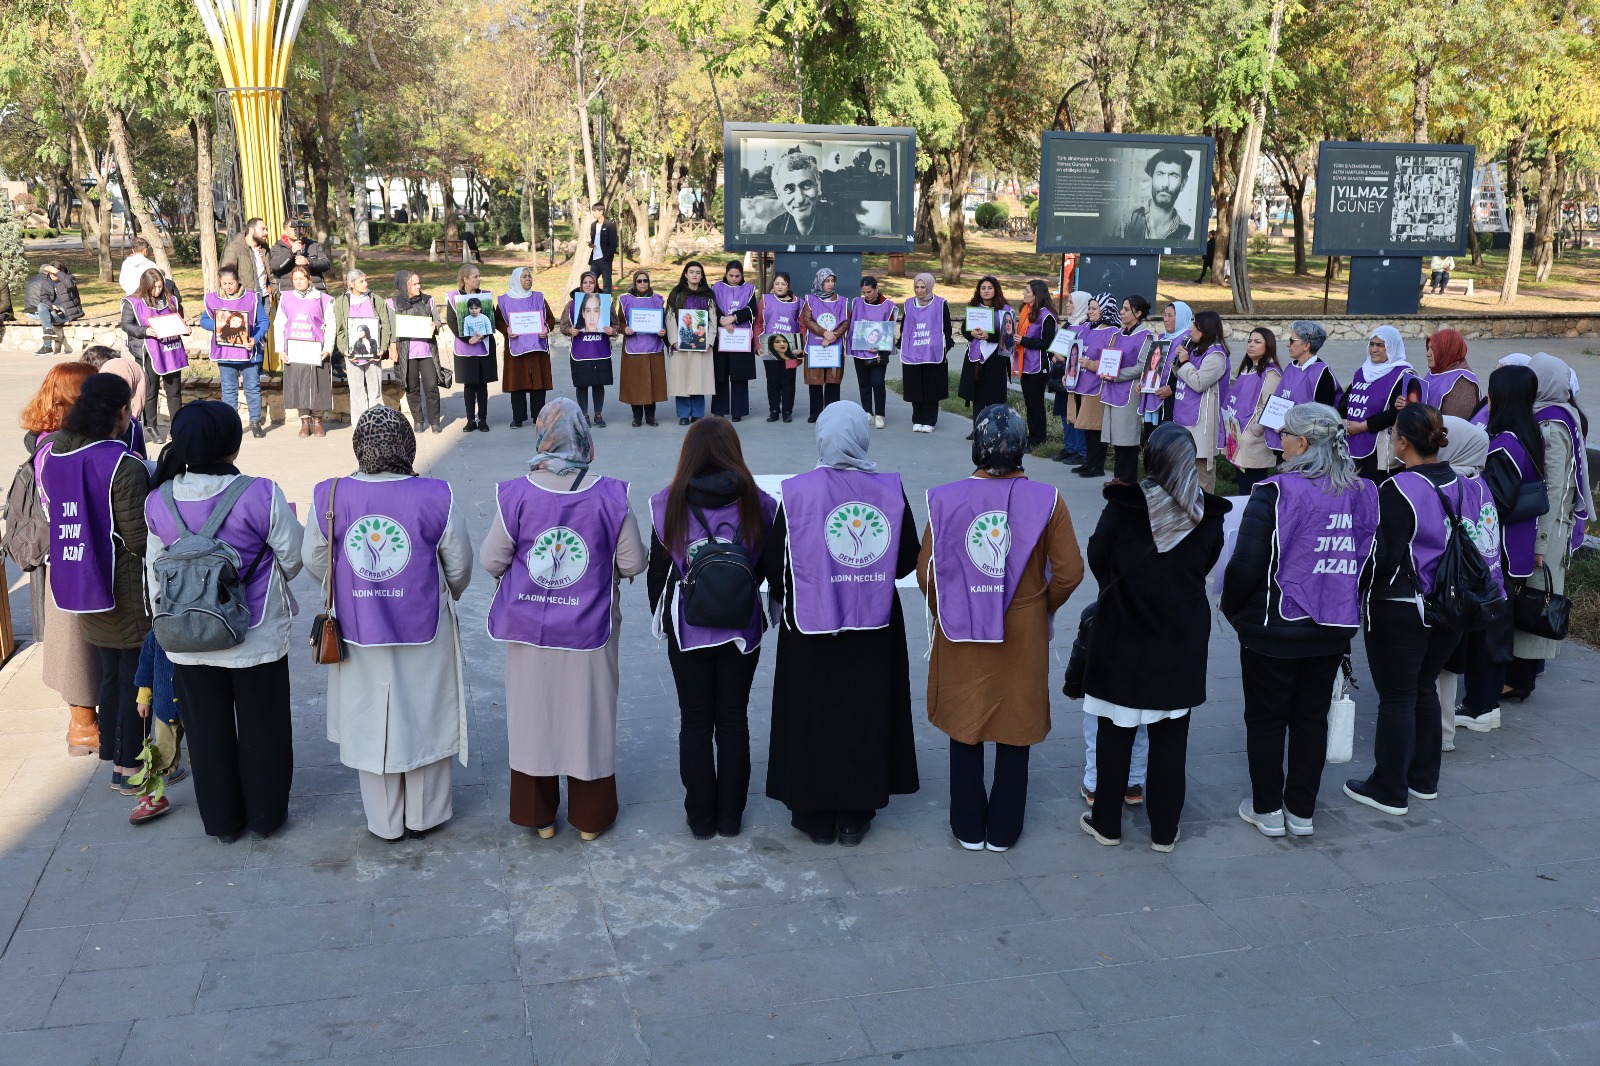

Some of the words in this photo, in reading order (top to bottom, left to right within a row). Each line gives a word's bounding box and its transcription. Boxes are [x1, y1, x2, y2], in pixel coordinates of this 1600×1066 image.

[1337, 186, 1388, 198] YILMAZ
[1337, 198, 1384, 213] GÜNEY
[62, 502, 78, 517] JIN
[1326, 514, 1353, 530] JIN
[838, 553, 854, 564] DEM
[358, 567, 372, 578] DEM
[982, 563, 995, 574] DEM
[854, 572, 886, 582] MECLİSİ
[374, 587, 404, 597] MECLİSİ
[518, 593, 545, 603] KADIN
[546, 595, 580, 606] MECLİSİ
